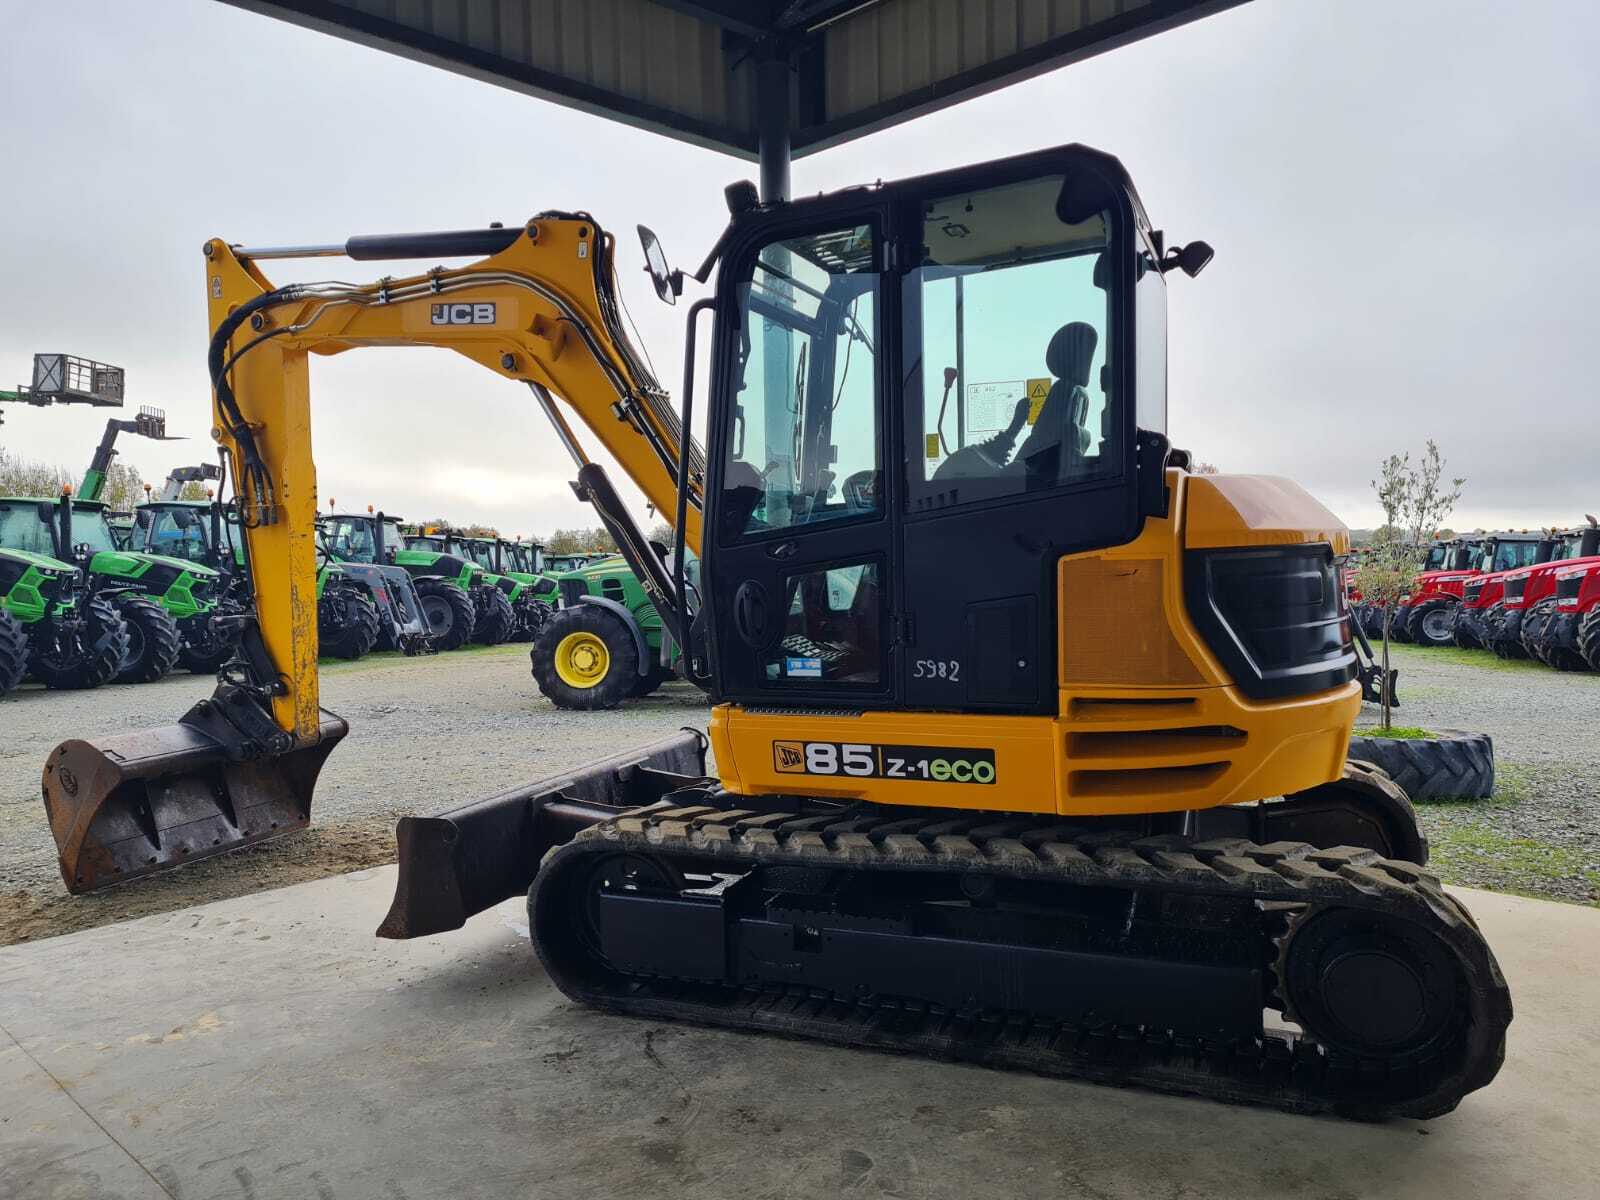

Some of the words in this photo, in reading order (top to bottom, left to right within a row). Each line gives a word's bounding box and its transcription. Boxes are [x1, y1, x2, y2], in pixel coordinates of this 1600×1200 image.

[432, 304, 494, 324] JCB
[913, 660, 960, 682] 5982
[778, 746, 801, 767] JCB
[805, 743, 875, 776] 85
